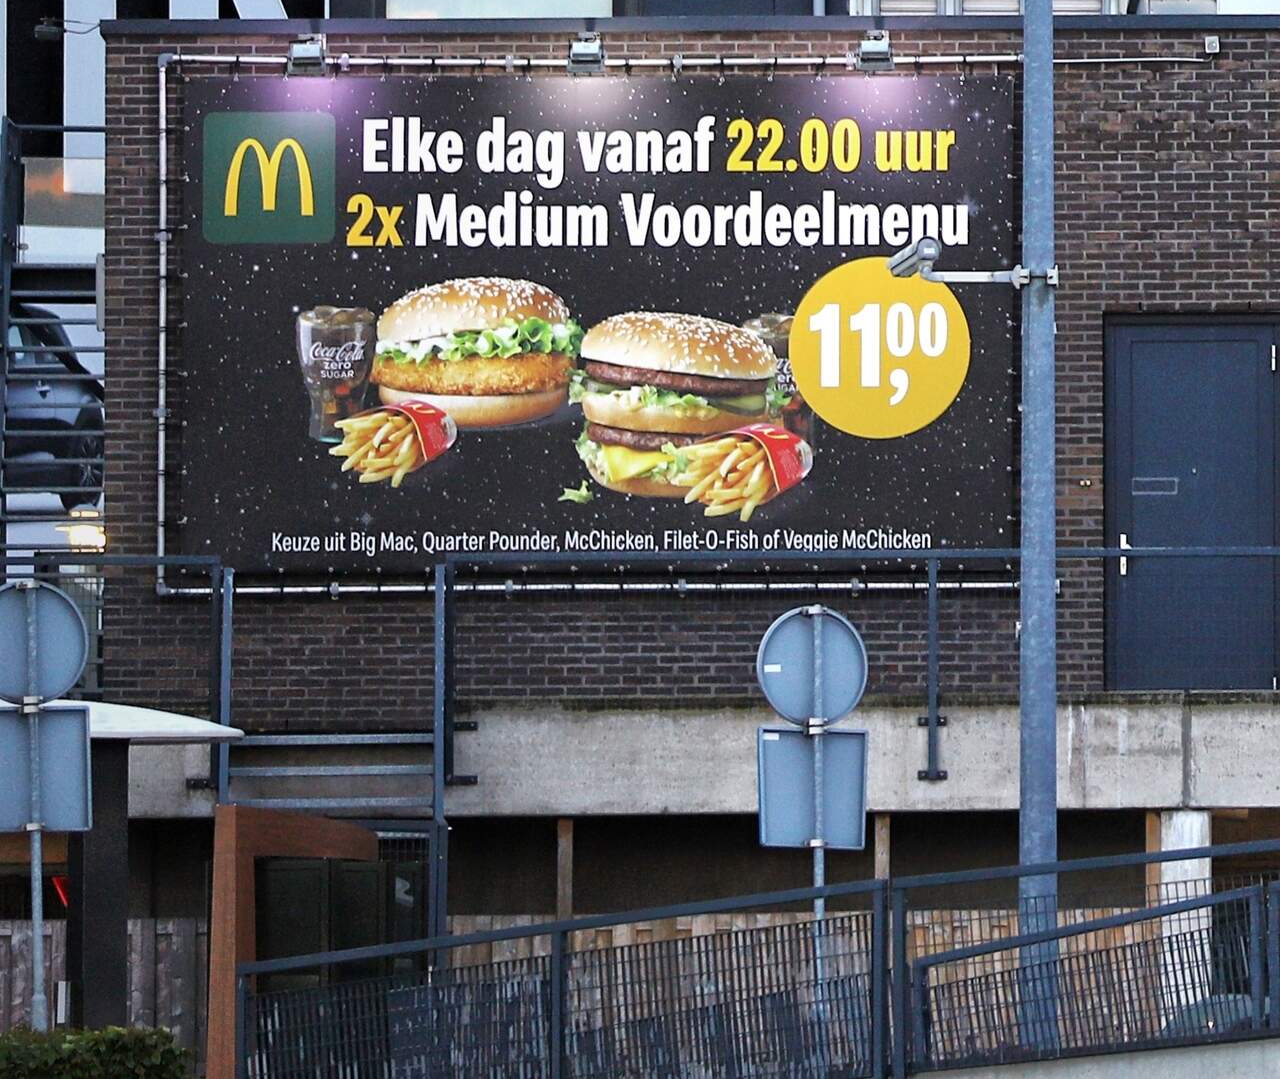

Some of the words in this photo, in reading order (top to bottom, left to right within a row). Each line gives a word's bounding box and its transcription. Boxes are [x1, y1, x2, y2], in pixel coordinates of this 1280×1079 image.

[362, 116, 464, 173] Elke
[475, 116, 565, 189] dag
[577, 115, 716, 173] vanaf
[726, 118, 861, 173] 22.00
[874, 129, 956, 172] uur
[346, 193, 405, 247] 2x
[414, 189, 609, 248] Medium
[620, 189, 970, 248] Voordeelmenu
[271, 531, 320, 552] Keuze
[324, 531, 346, 552] uit
[350, 531, 376, 557] Big
[380, 531, 418, 555] Mac,
[422, 530, 485, 553] Quarter
[489, 530, 561, 553] Pounder,
[565, 529, 659, 553] McChicken,
[663, 529, 759, 551] Filet-O-Fish
[763, 529, 781, 551] of
[783, 529, 839, 552] Veggie
[842, 528, 932, 550] McChicken
